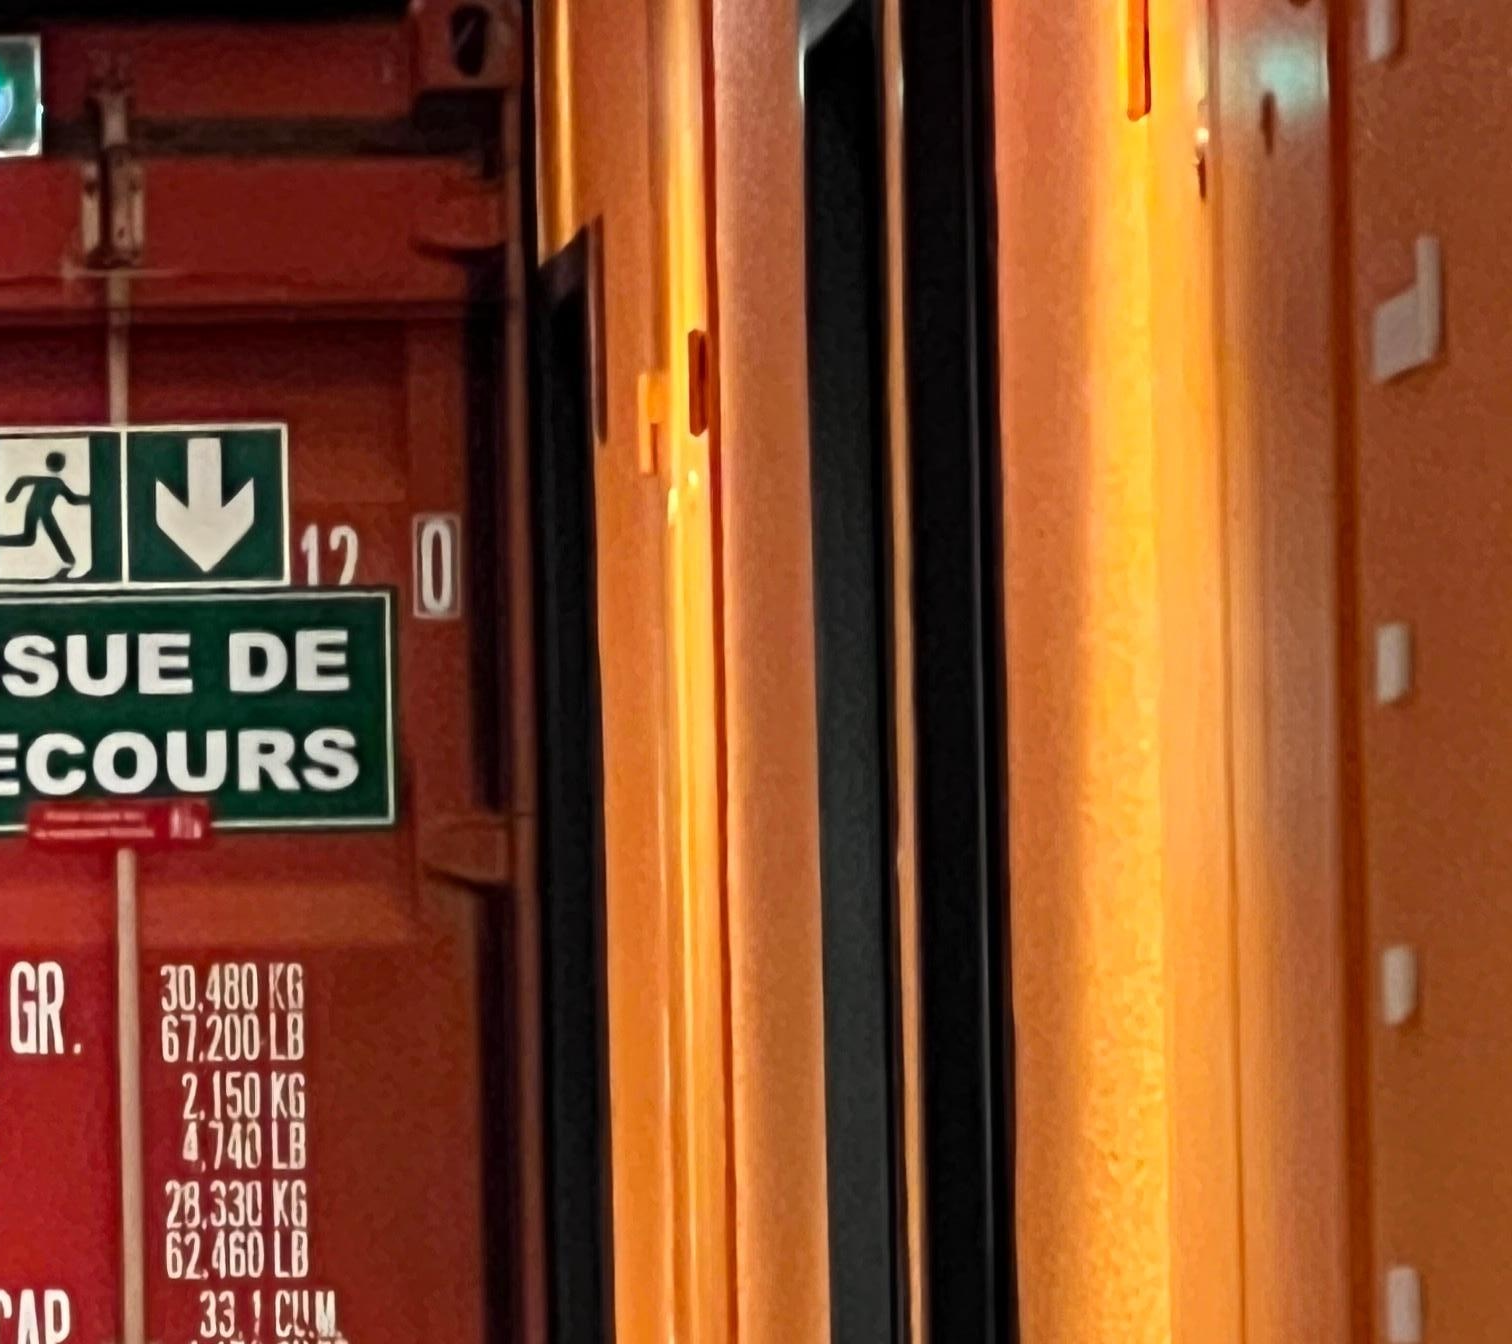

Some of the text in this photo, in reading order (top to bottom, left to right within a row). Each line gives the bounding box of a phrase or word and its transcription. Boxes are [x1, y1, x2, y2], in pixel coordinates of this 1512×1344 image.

[228, 629, 350, 693] DE
[9, 961, 82, 1055] GR.
[268, 962, 304, 1011] KG
[269, 1012, 305, 1061] LB
[270, 1070, 306, 1119] KG
[271, 1120, 307, 1170] LB
[272, 1178, 308, 1228] KG
[273, 1229, 309, 1279] LB
